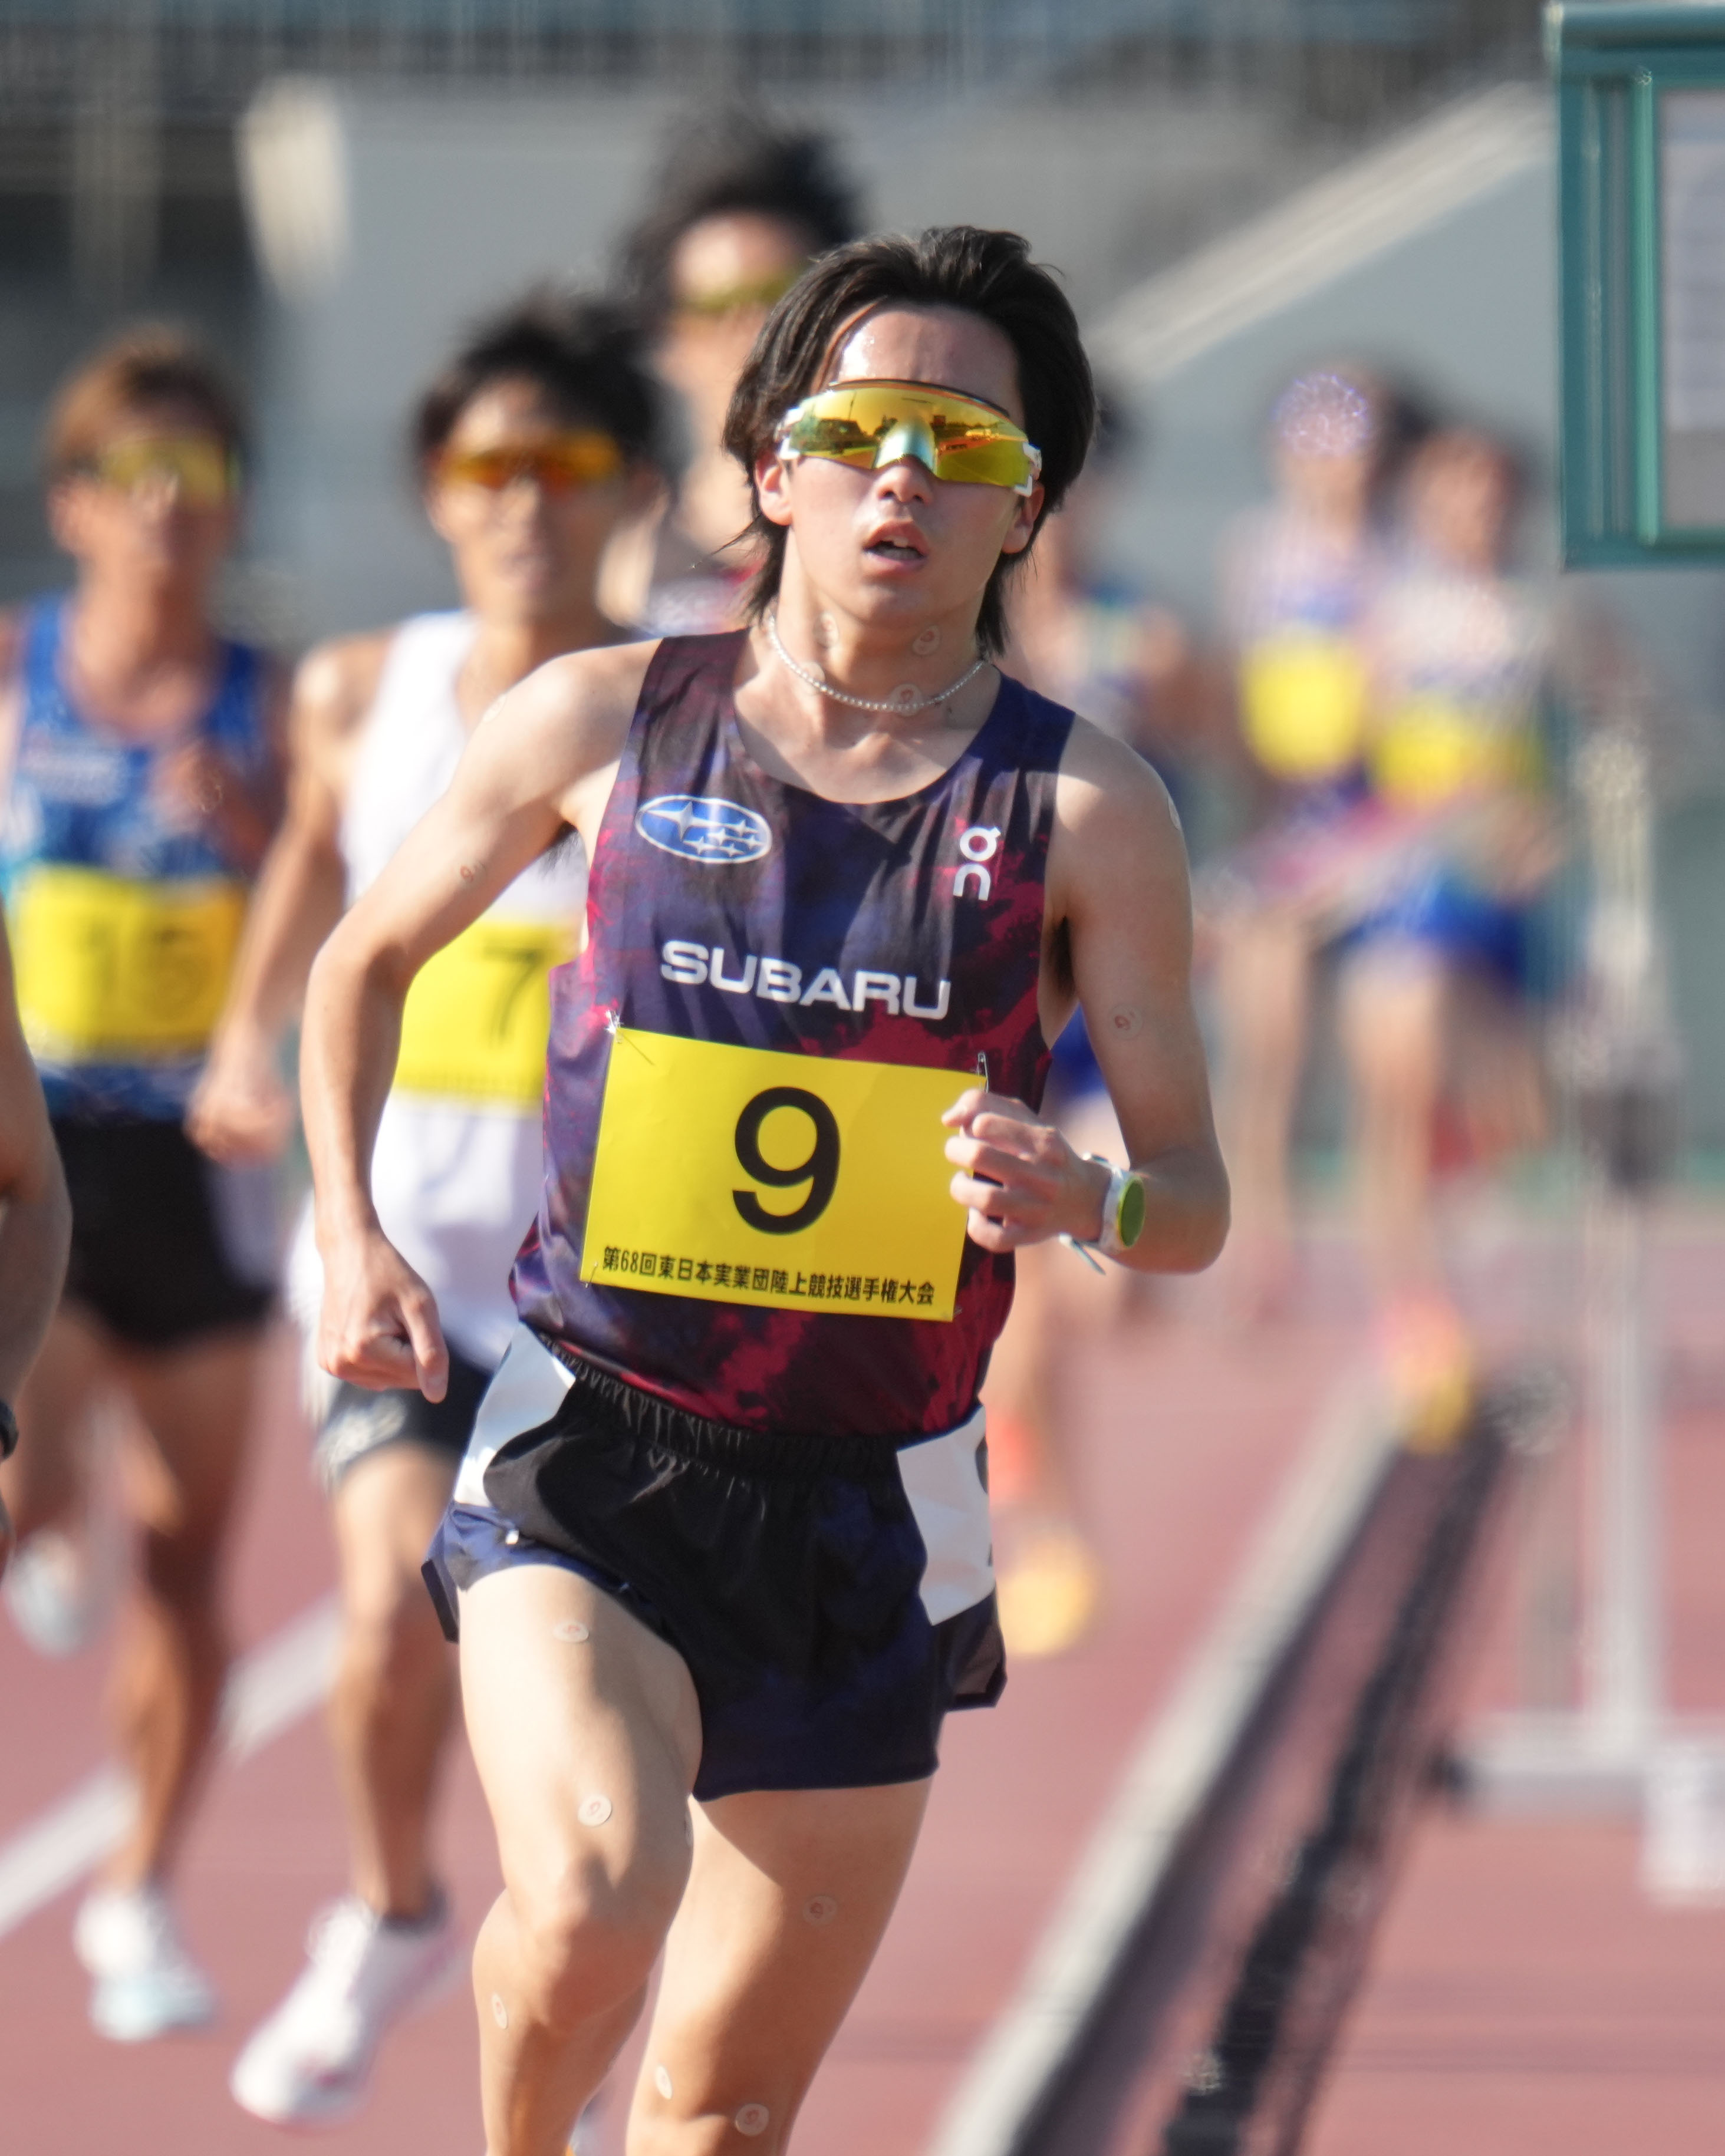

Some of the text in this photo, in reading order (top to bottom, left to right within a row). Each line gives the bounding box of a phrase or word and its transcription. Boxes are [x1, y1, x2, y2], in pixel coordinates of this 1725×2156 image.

[480, 942, 549, 1046] 7
[660, 940, 950, 1020] SUBARU
[732, 1086, 841, 1235] 9
[603, 1245, 935, 1306] 第68回東日本実業団陸上競技選手権大会
